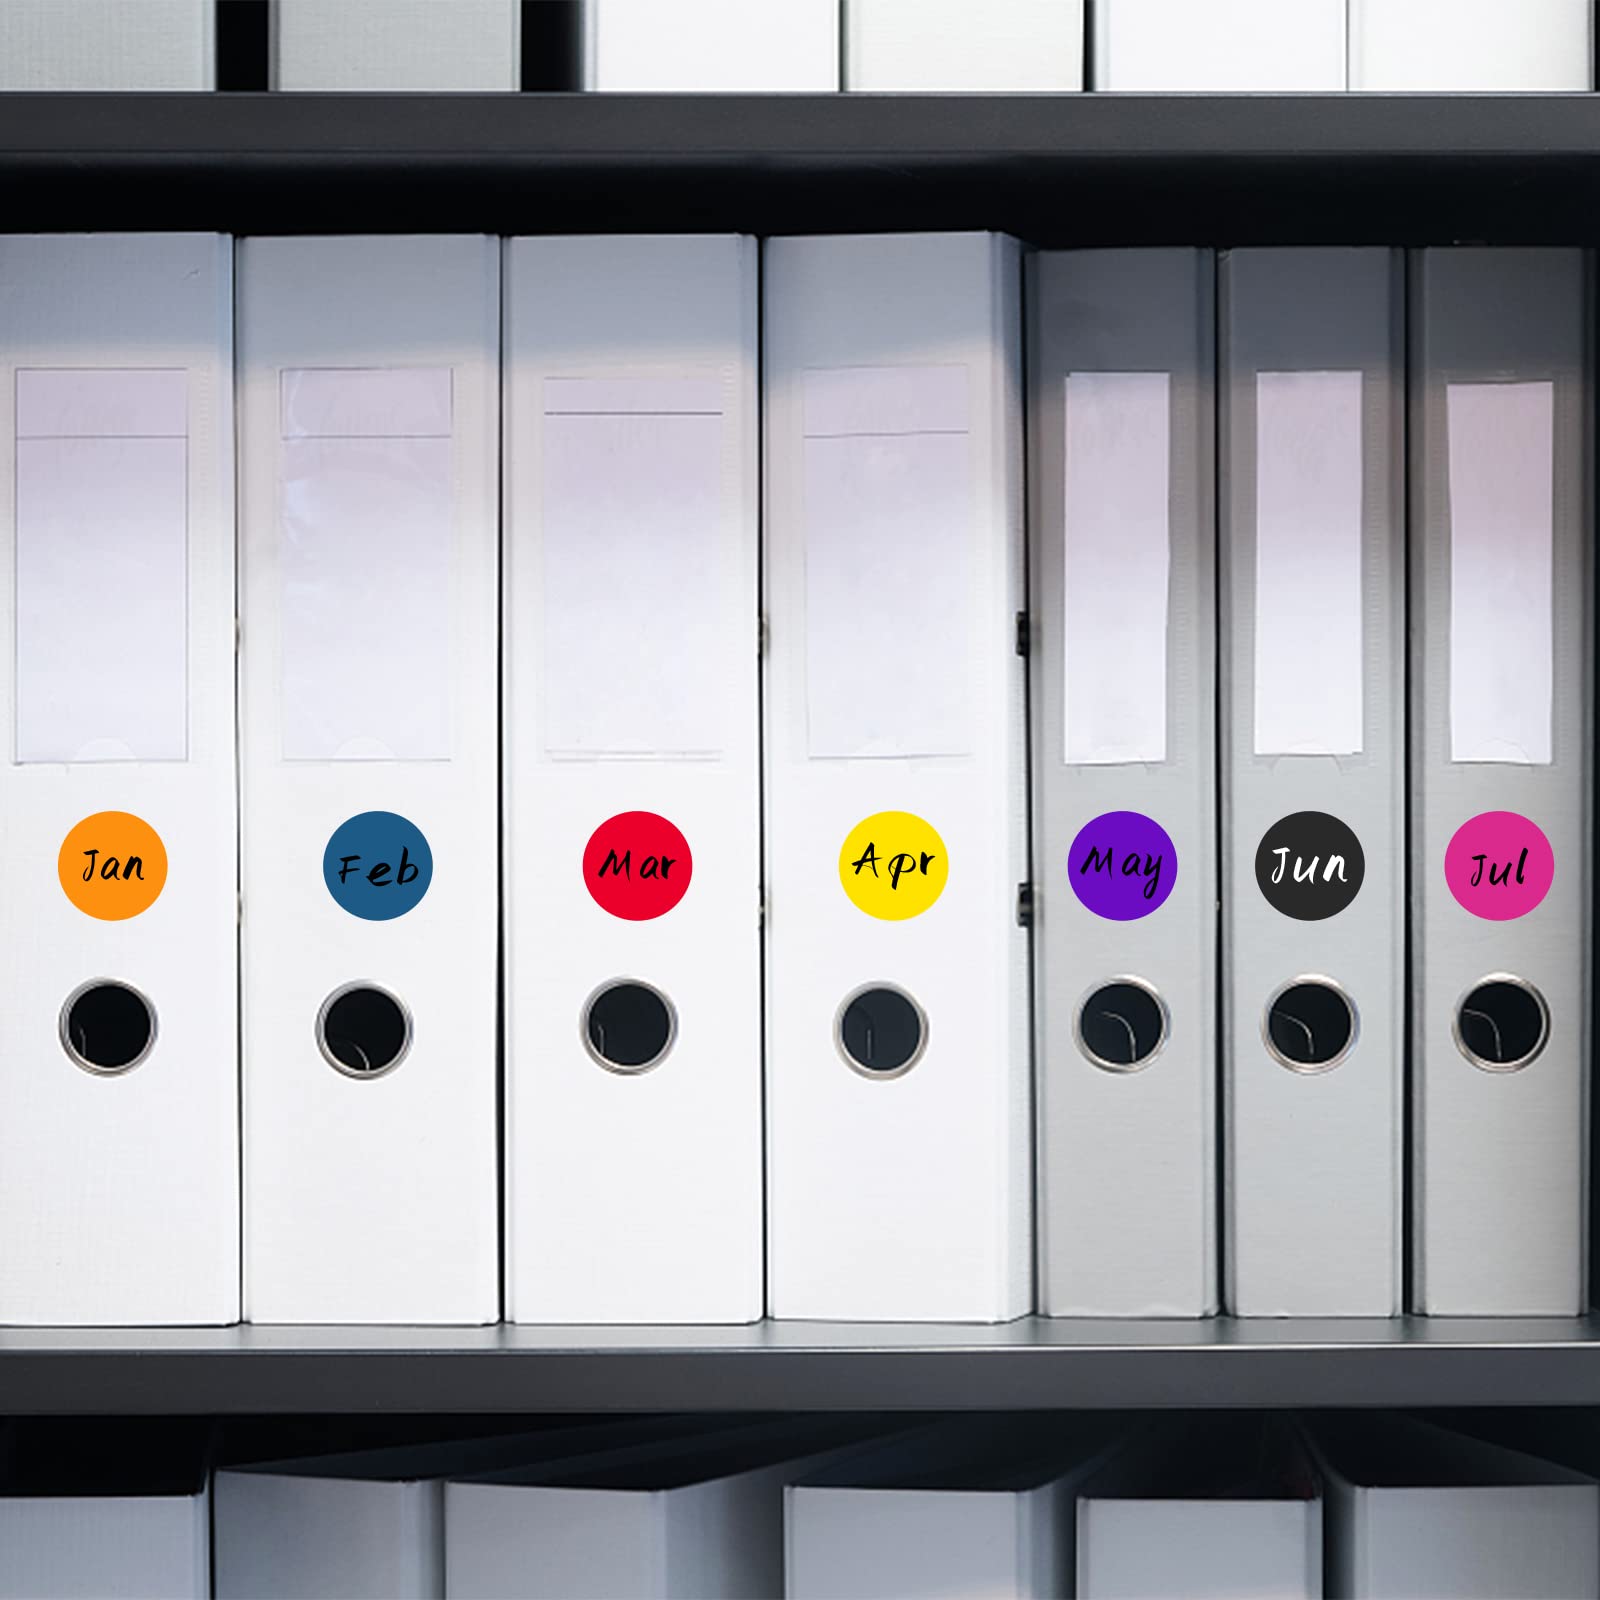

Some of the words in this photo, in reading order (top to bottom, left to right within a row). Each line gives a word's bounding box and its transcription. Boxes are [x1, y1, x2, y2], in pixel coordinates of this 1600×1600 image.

[83, 850, 144, 882] Jan
[340, 847, 418, 886] Feb
[600, 850, 676, 881] Mar
[852, 843, 935, 889] Apr
[1081, 847, 1162, 899] May
[1272, 848, 1348, 884] Jun
[1472, 849, 1528, 886] Jul
